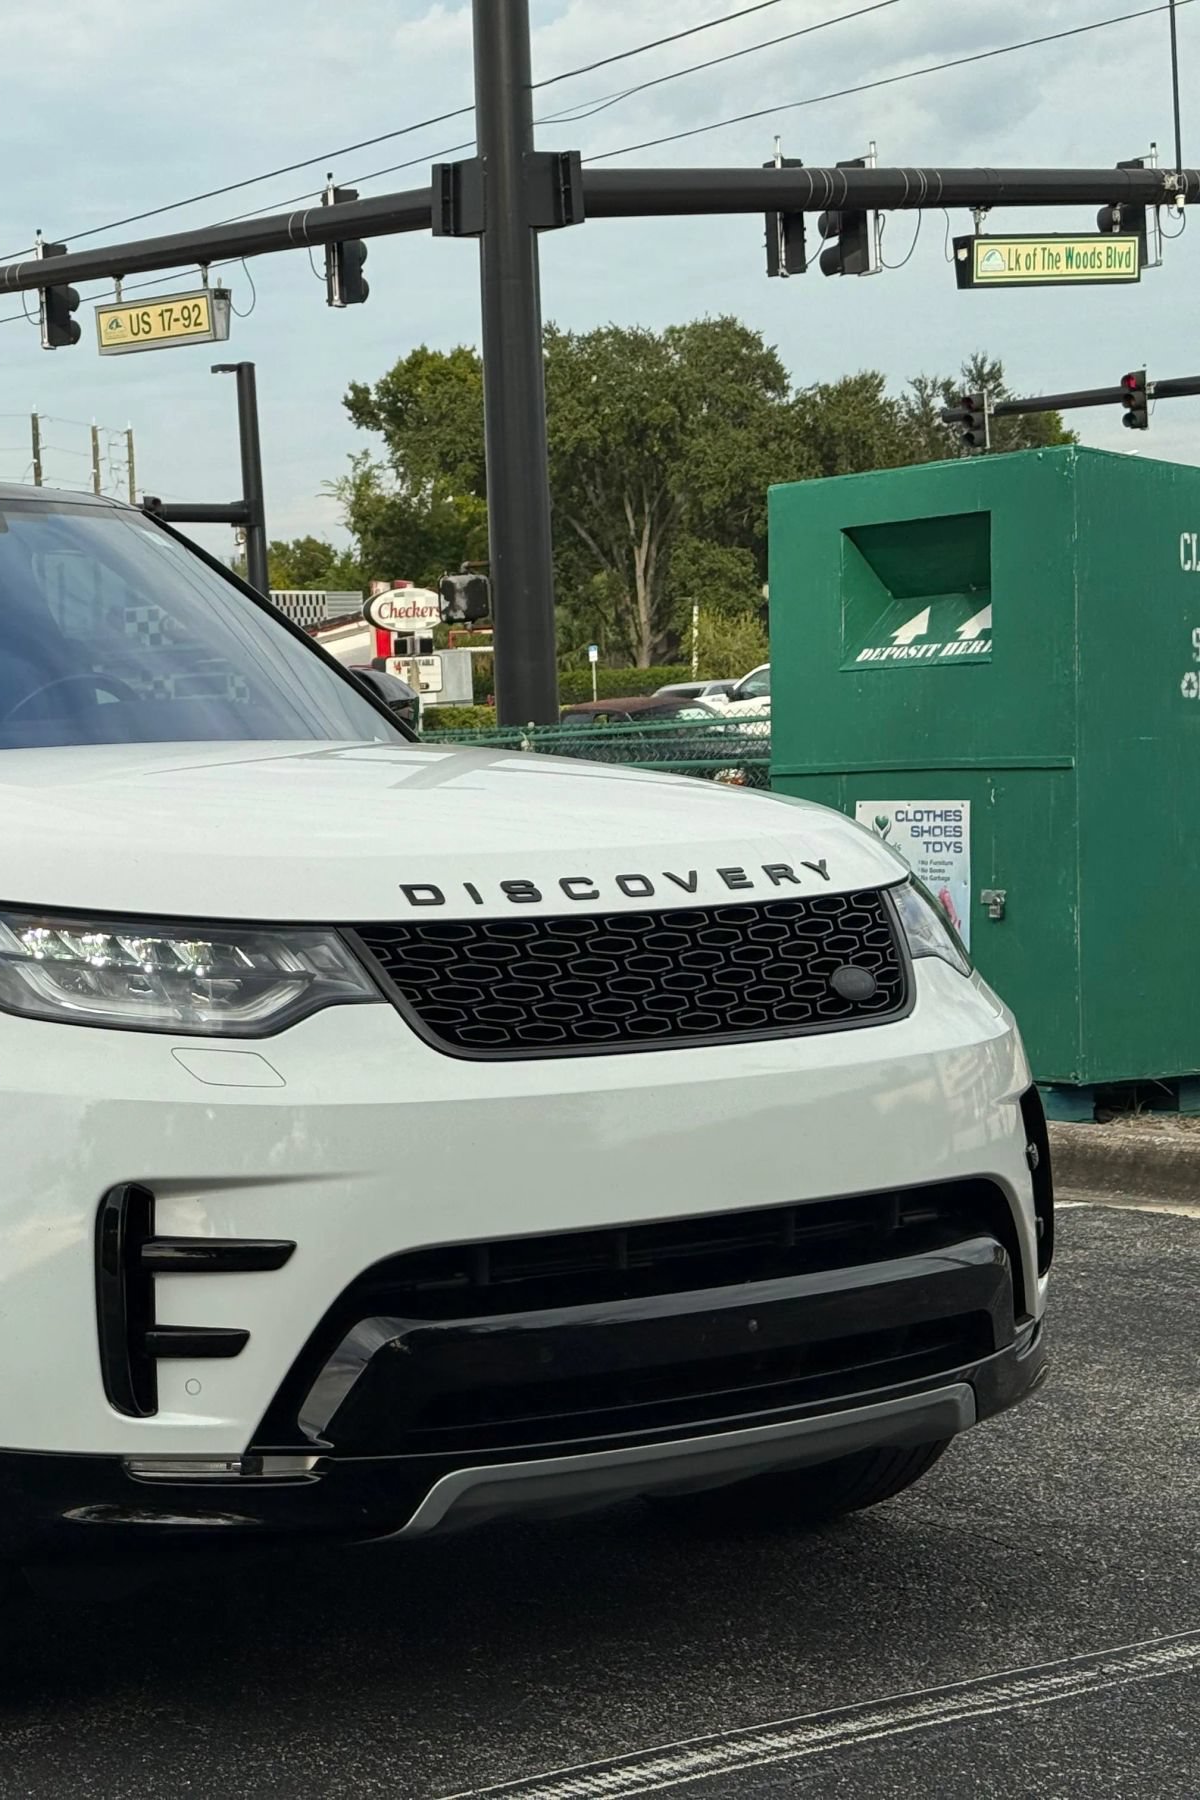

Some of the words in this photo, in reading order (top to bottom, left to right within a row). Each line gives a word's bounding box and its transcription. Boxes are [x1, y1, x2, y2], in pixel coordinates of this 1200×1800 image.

[1008, 248, 1021, 271] Lk
[1025, 249, 1037, 271] of
[1040, 247, 1061, 270] The
[1065, 246, 1103, 269] Woods
[1106, 246, 1131, 269] Blvd
[129, 311, 151, 336] US
[158, 303, 203, 332] 17-92
[378, 601, 441, 620] Checkers
[855, 643, 942, 662] DEPOSIT
[895, 810, 963, 822] CLOTHES
[910, 825, 963, 838] SHOES
[923, 841, 963, 853] TOYS
[399, 858, 831, 906] DISCOVERY
